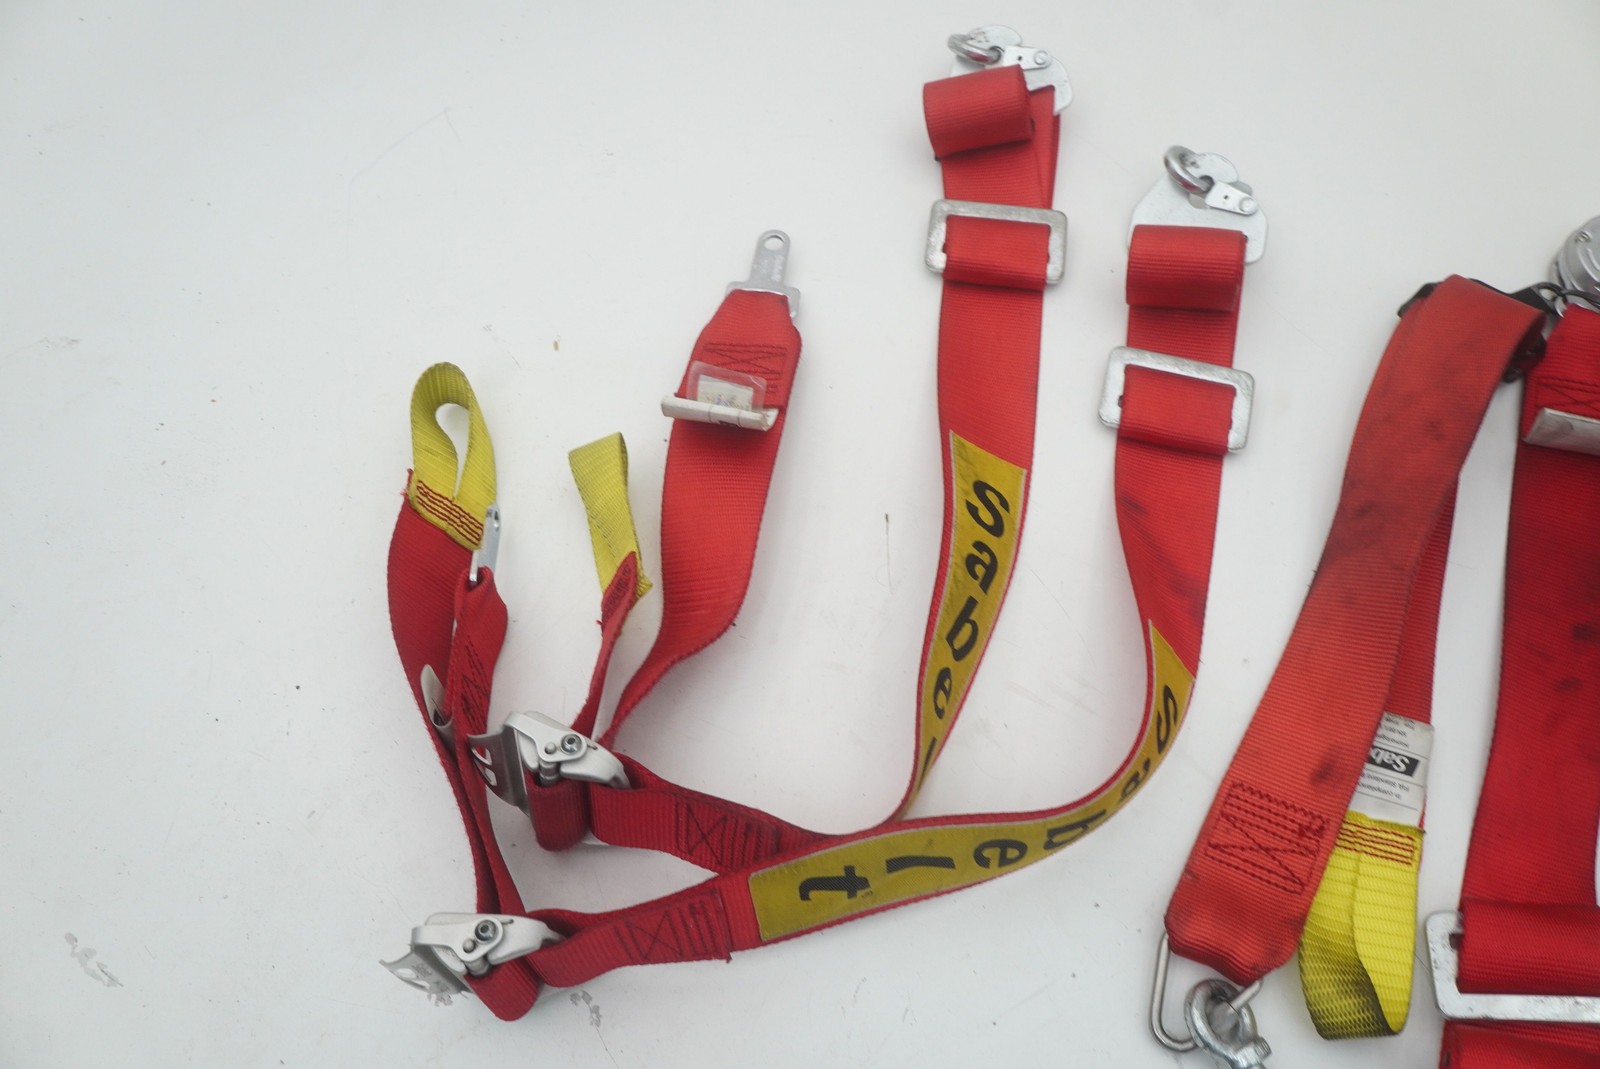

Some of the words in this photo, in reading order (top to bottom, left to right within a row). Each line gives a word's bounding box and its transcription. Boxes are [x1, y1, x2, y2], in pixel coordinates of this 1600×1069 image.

[917, 479, 1010, 793] Sabel
[799, 684, 1179, 901] Sabelt
[1369, 748, 1410, 773] Sab
